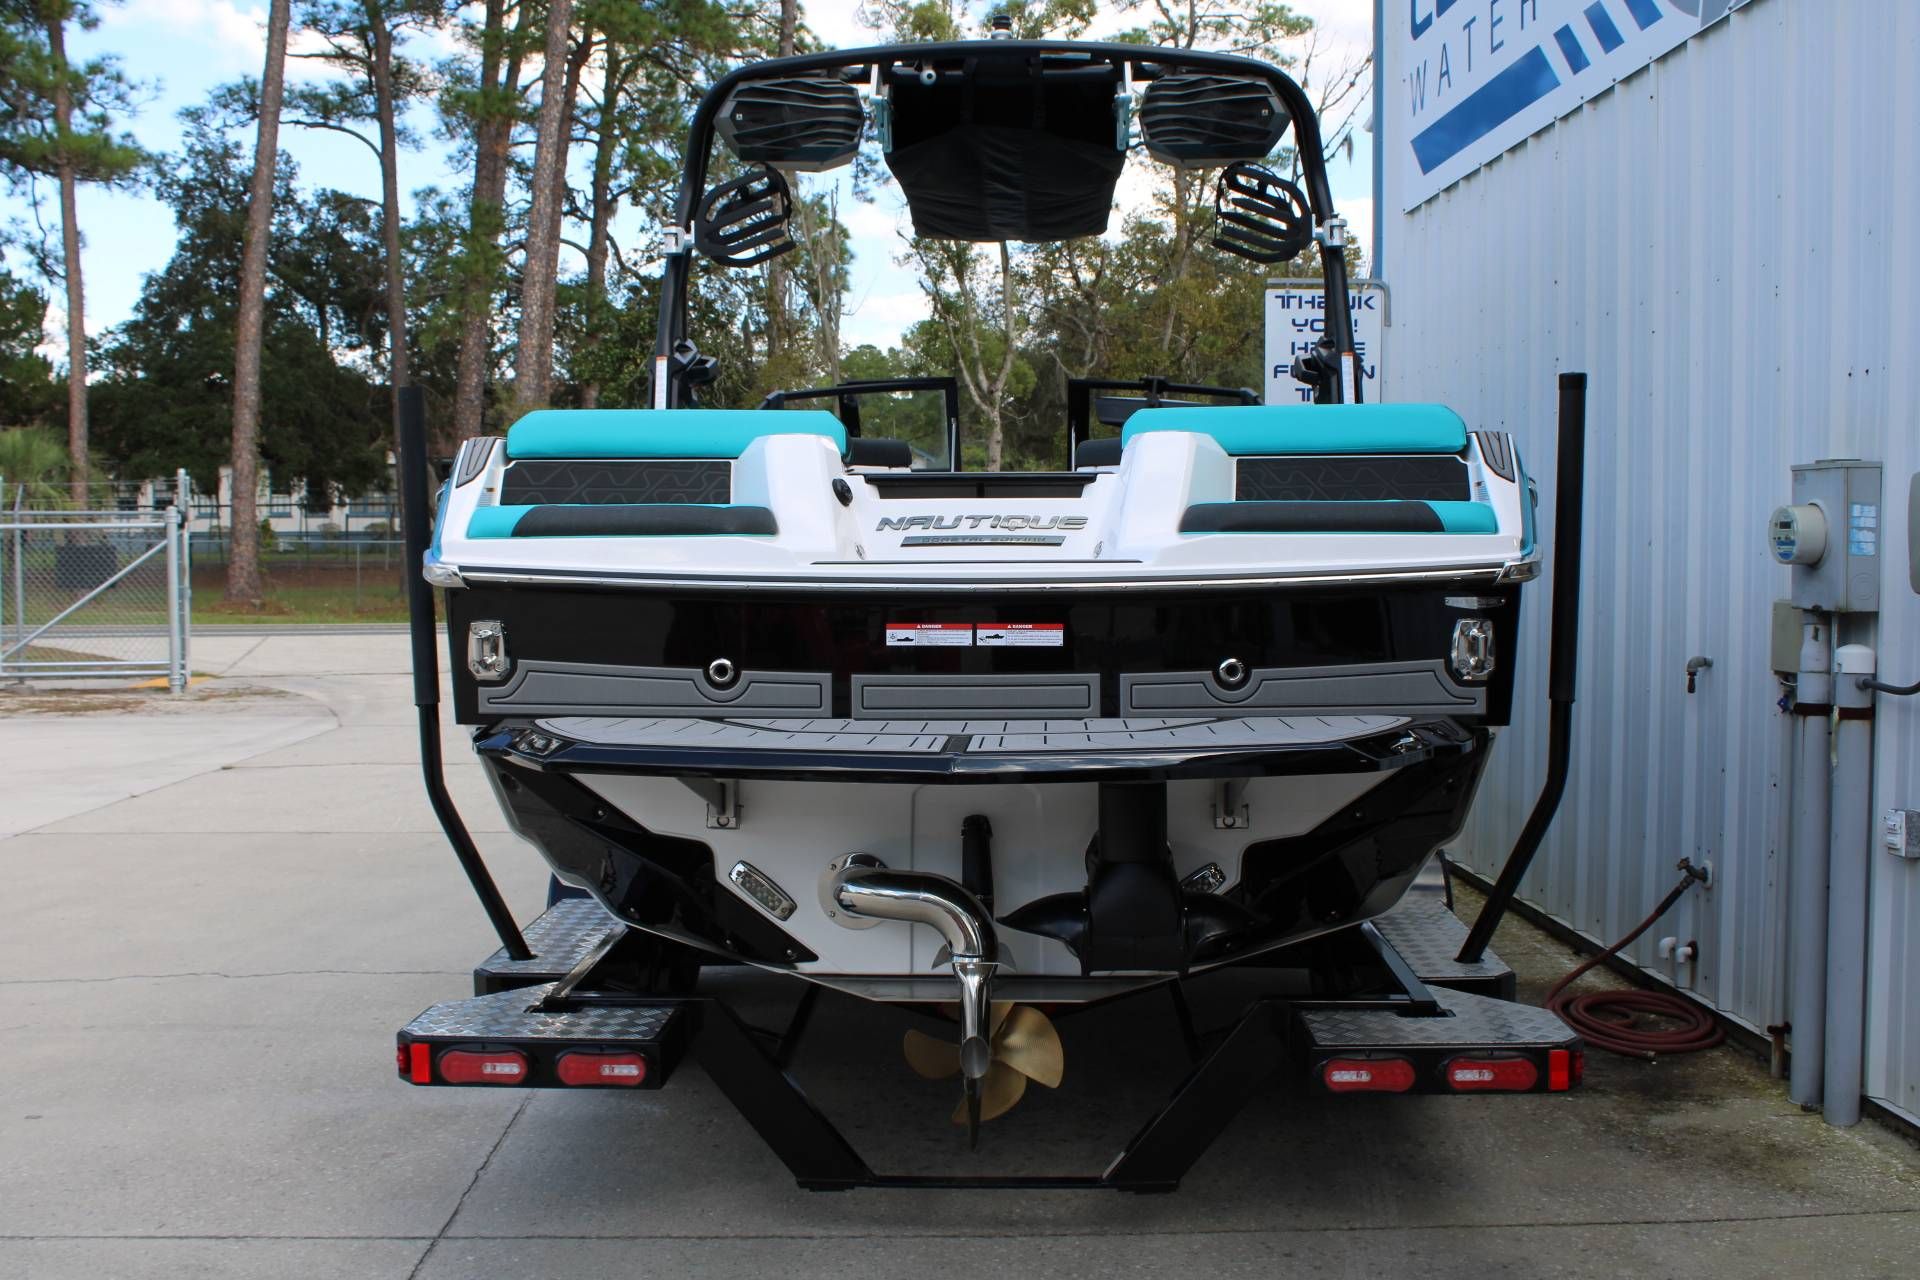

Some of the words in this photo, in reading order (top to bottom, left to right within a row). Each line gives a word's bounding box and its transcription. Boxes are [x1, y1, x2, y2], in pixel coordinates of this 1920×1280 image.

[1274, 295, 1376, 310] THK
[1291, 318, 1358, 333] YO!
[1291, 341, 1366, 356] HE
[875, 514, 1089, 532] NAUTIQUE
